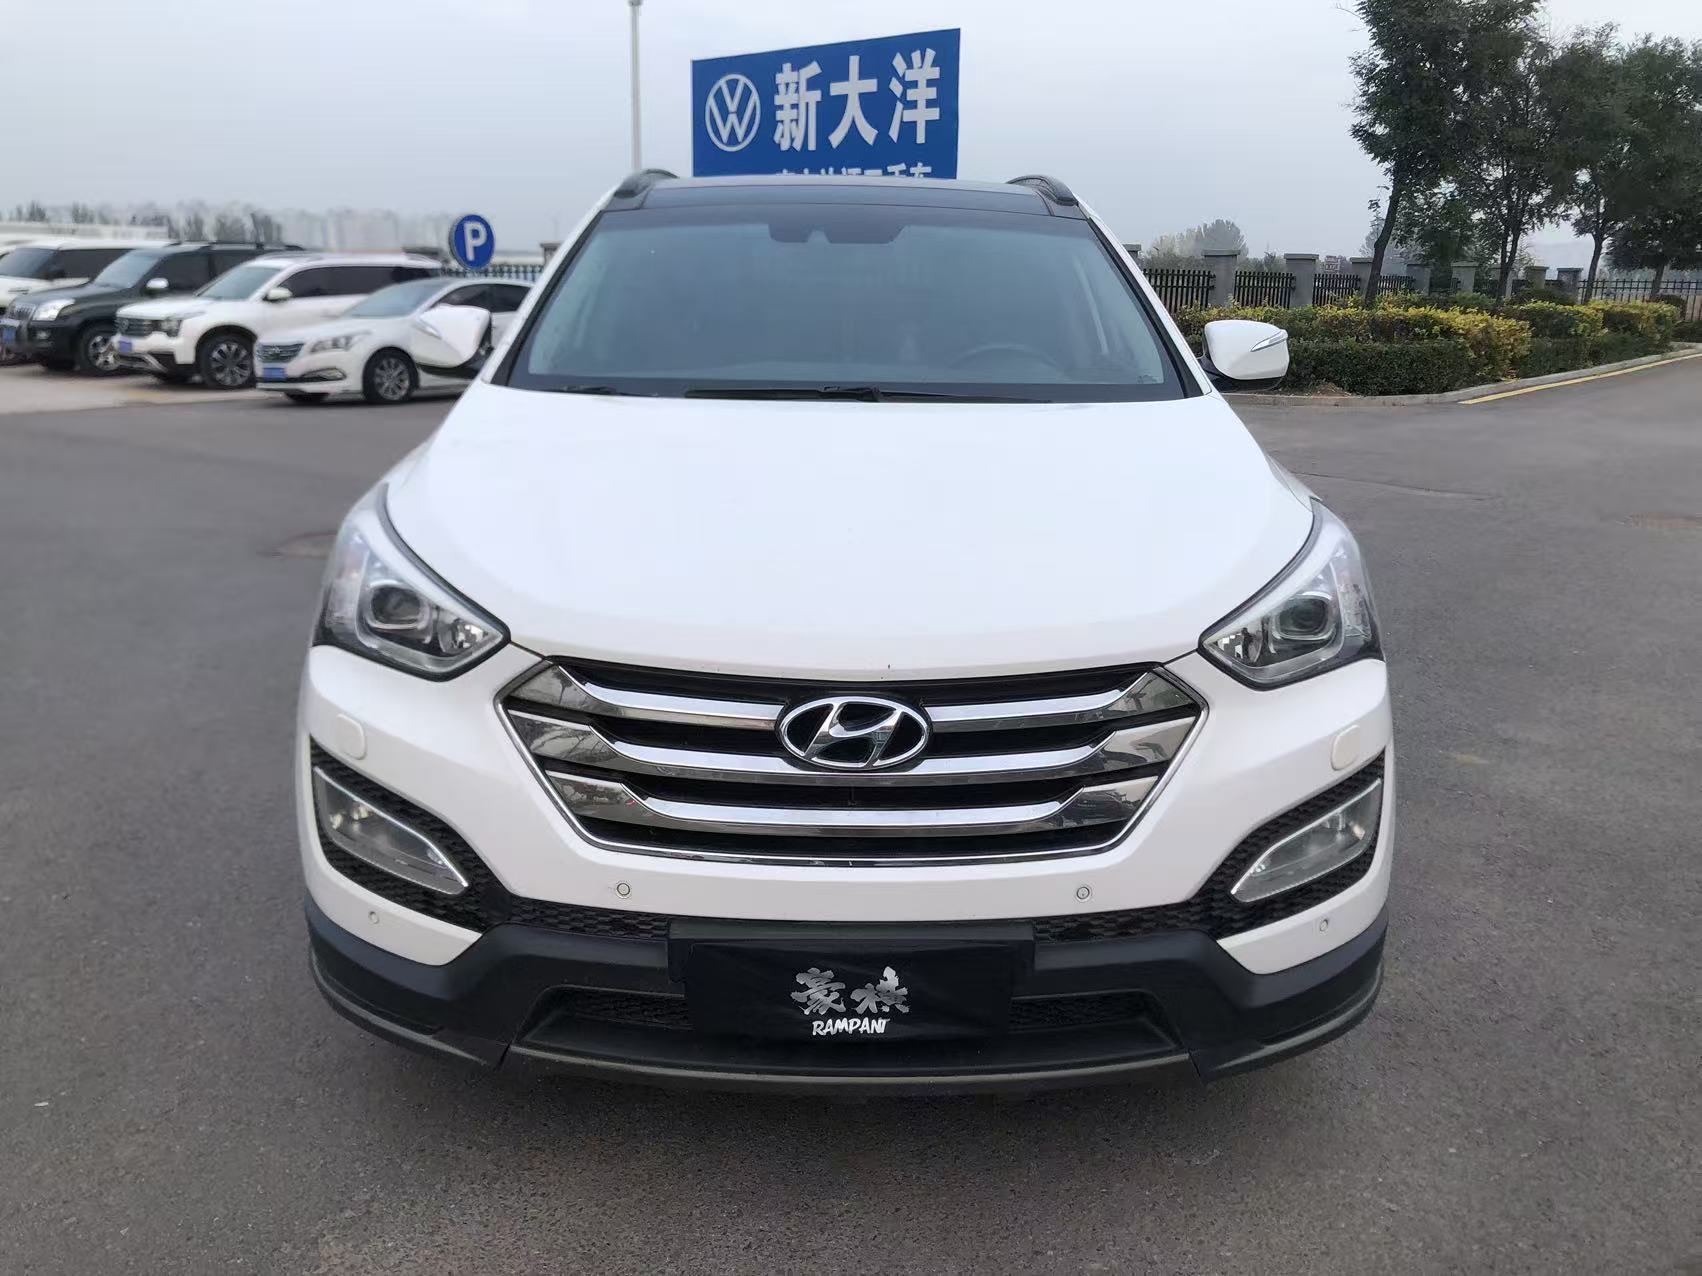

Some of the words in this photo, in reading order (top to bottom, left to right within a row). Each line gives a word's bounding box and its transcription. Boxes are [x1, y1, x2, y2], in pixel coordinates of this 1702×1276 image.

[773, 48, 941, 151] 新大洋
[463, 221, 488, 261] P
[812, 1017, 891, 1036] RAMPANT
